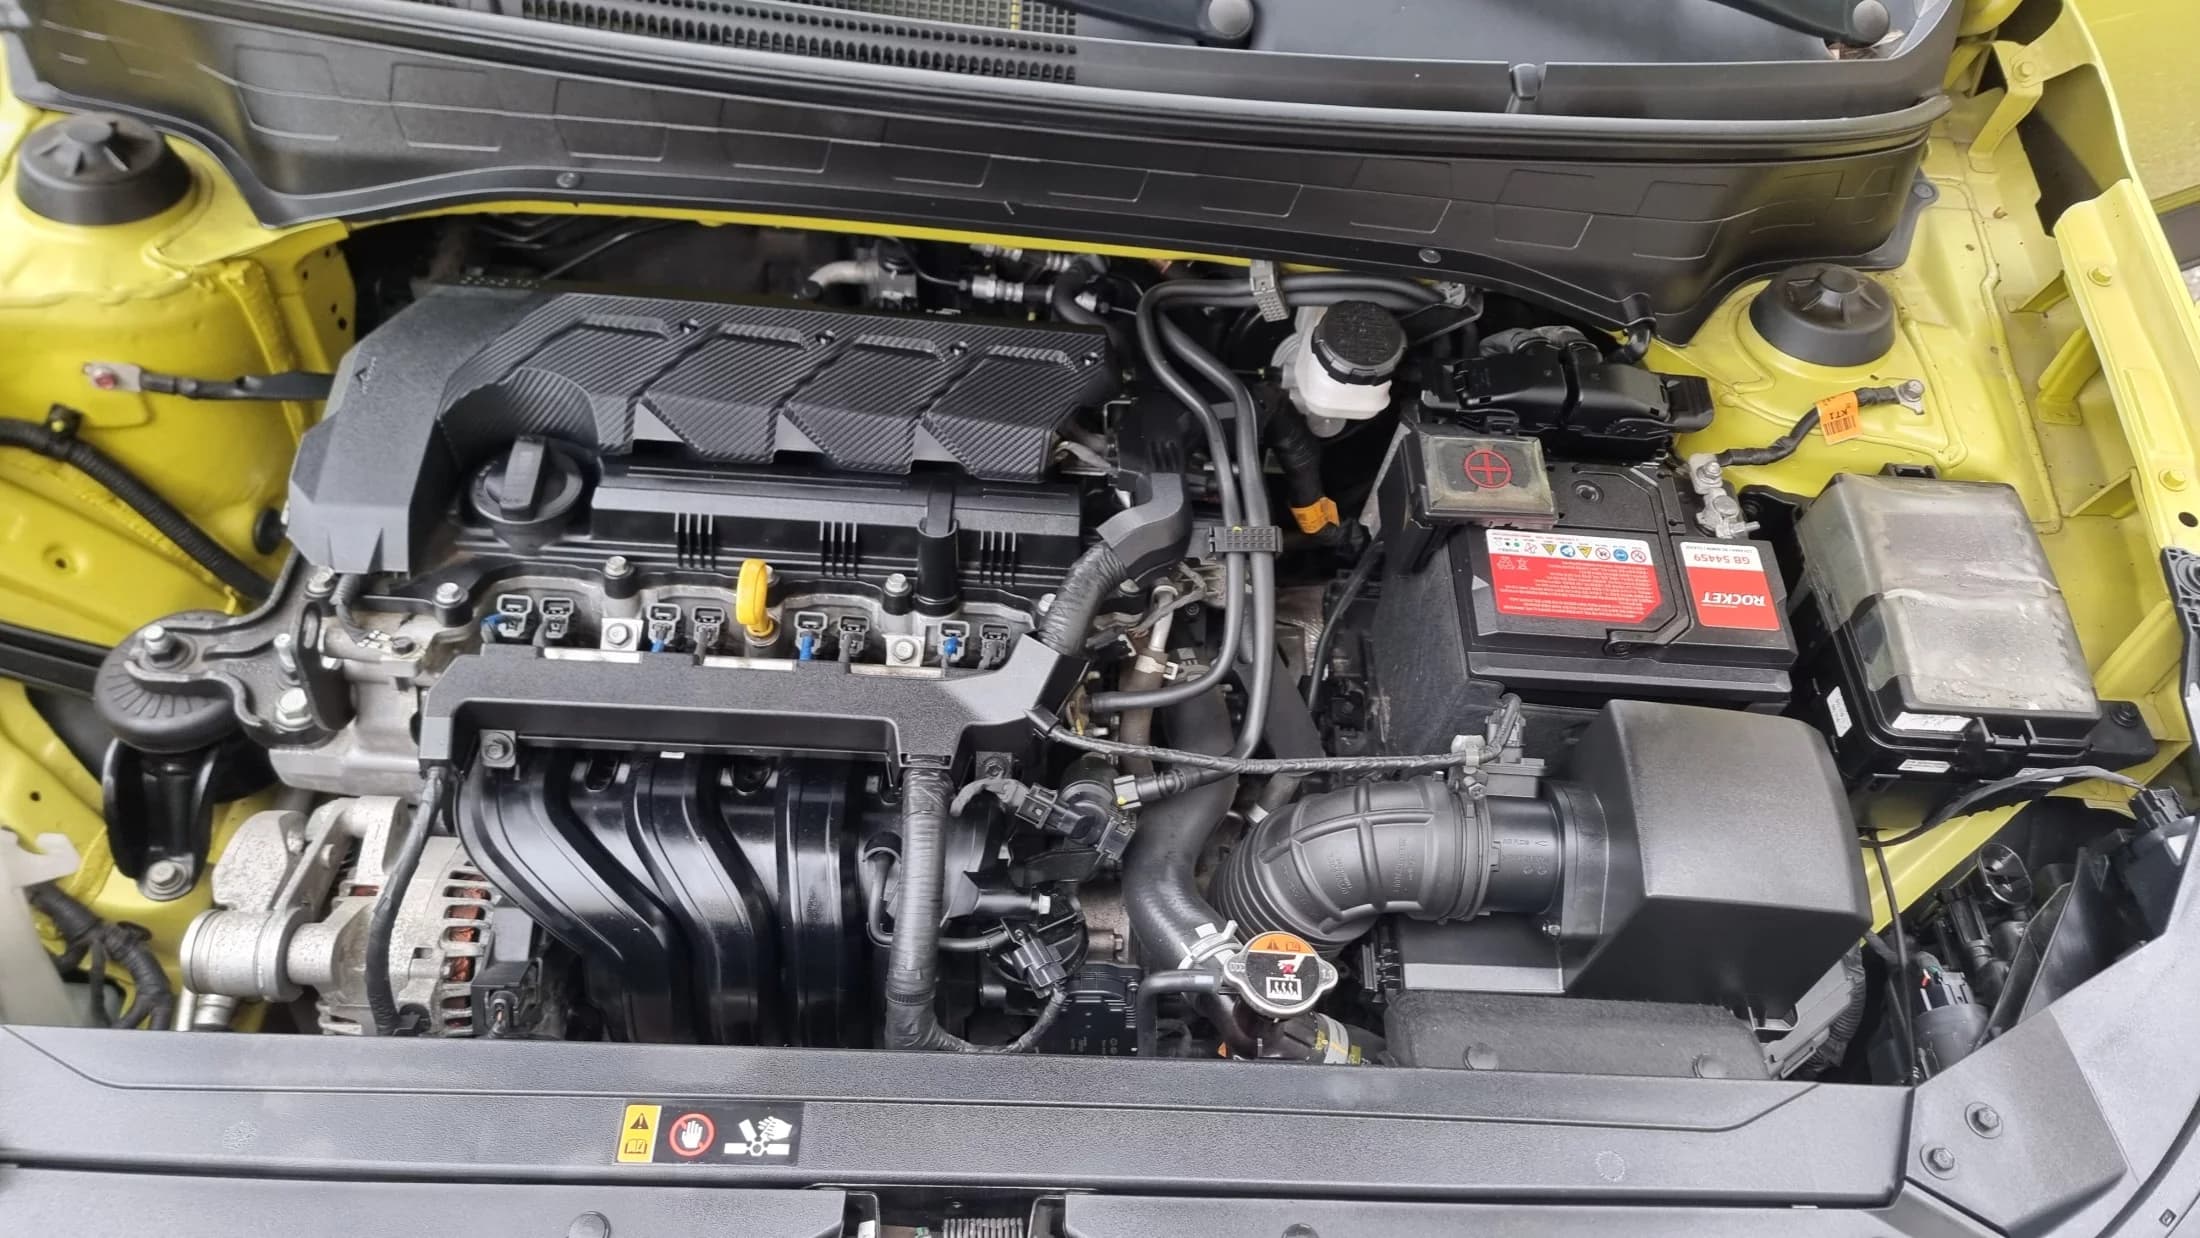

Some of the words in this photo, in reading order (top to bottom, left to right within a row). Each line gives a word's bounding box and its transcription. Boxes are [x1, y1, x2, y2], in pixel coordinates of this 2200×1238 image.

[1694, 553, 1730, 563] 54459
[1733, 556, 1750, 565] GB
[1702, 592, 1765, 606] ROCKET
